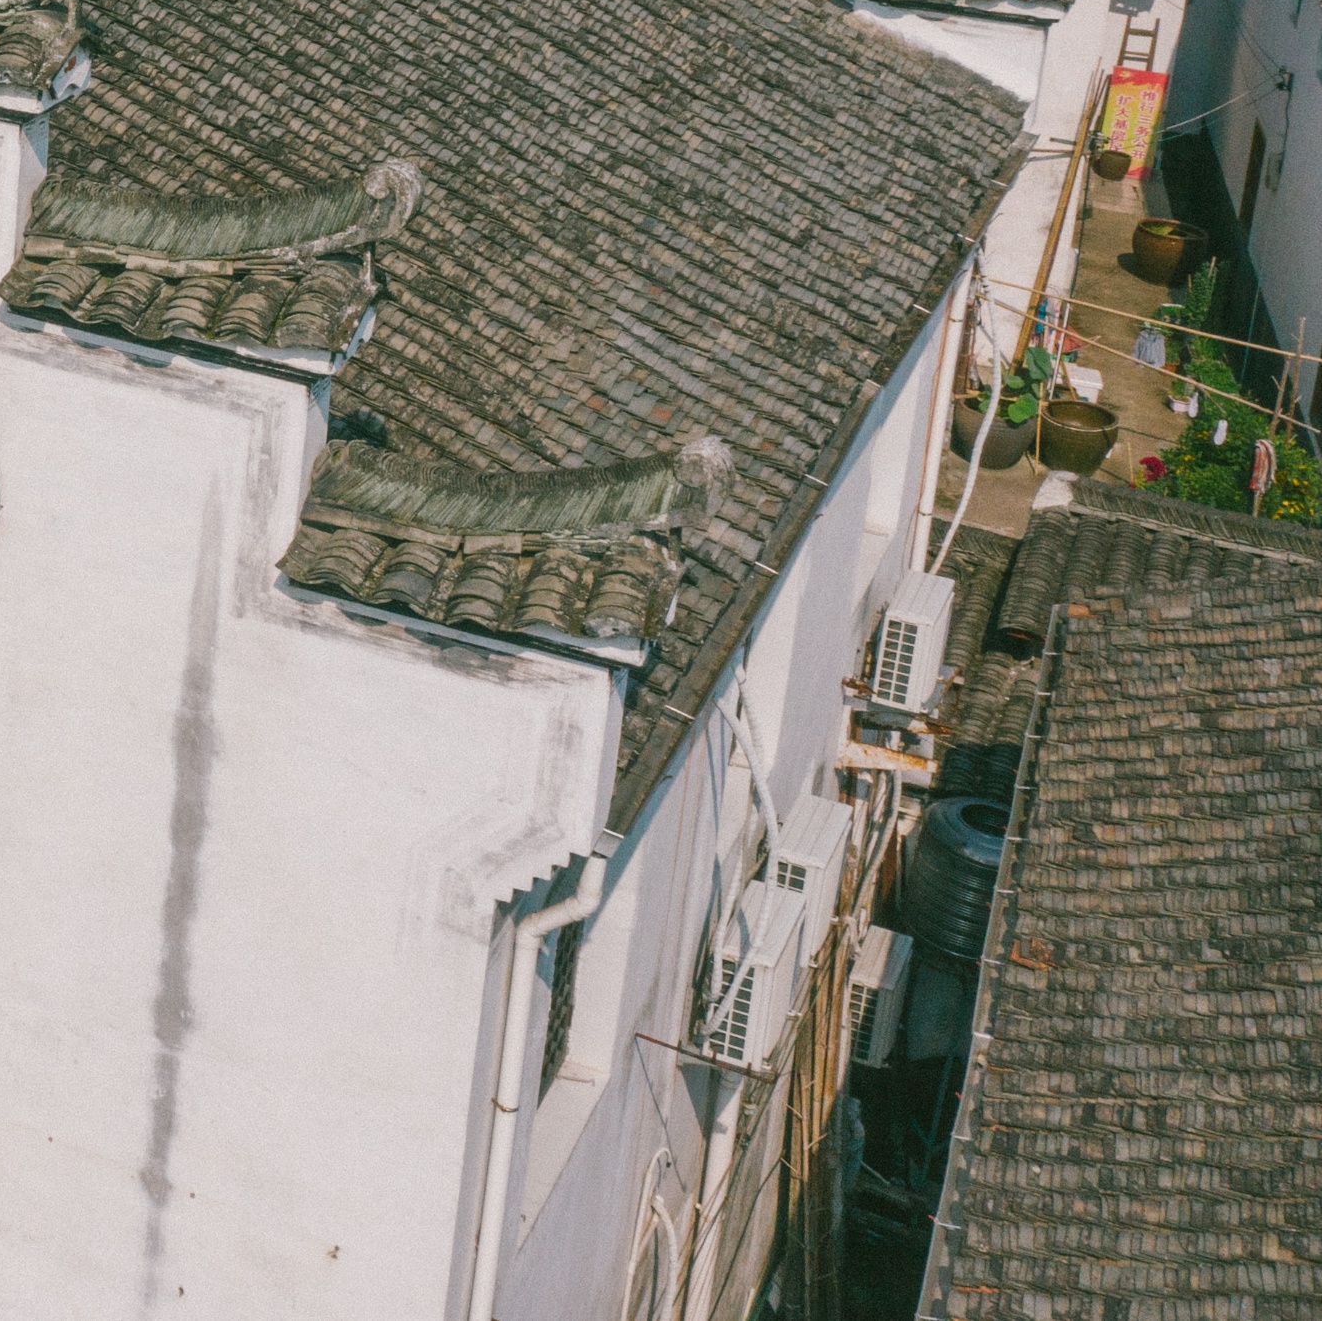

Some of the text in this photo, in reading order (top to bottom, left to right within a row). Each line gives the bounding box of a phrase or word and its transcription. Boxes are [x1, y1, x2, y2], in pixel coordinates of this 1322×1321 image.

[1130, 90, 1158, 160] 推行三务公开
